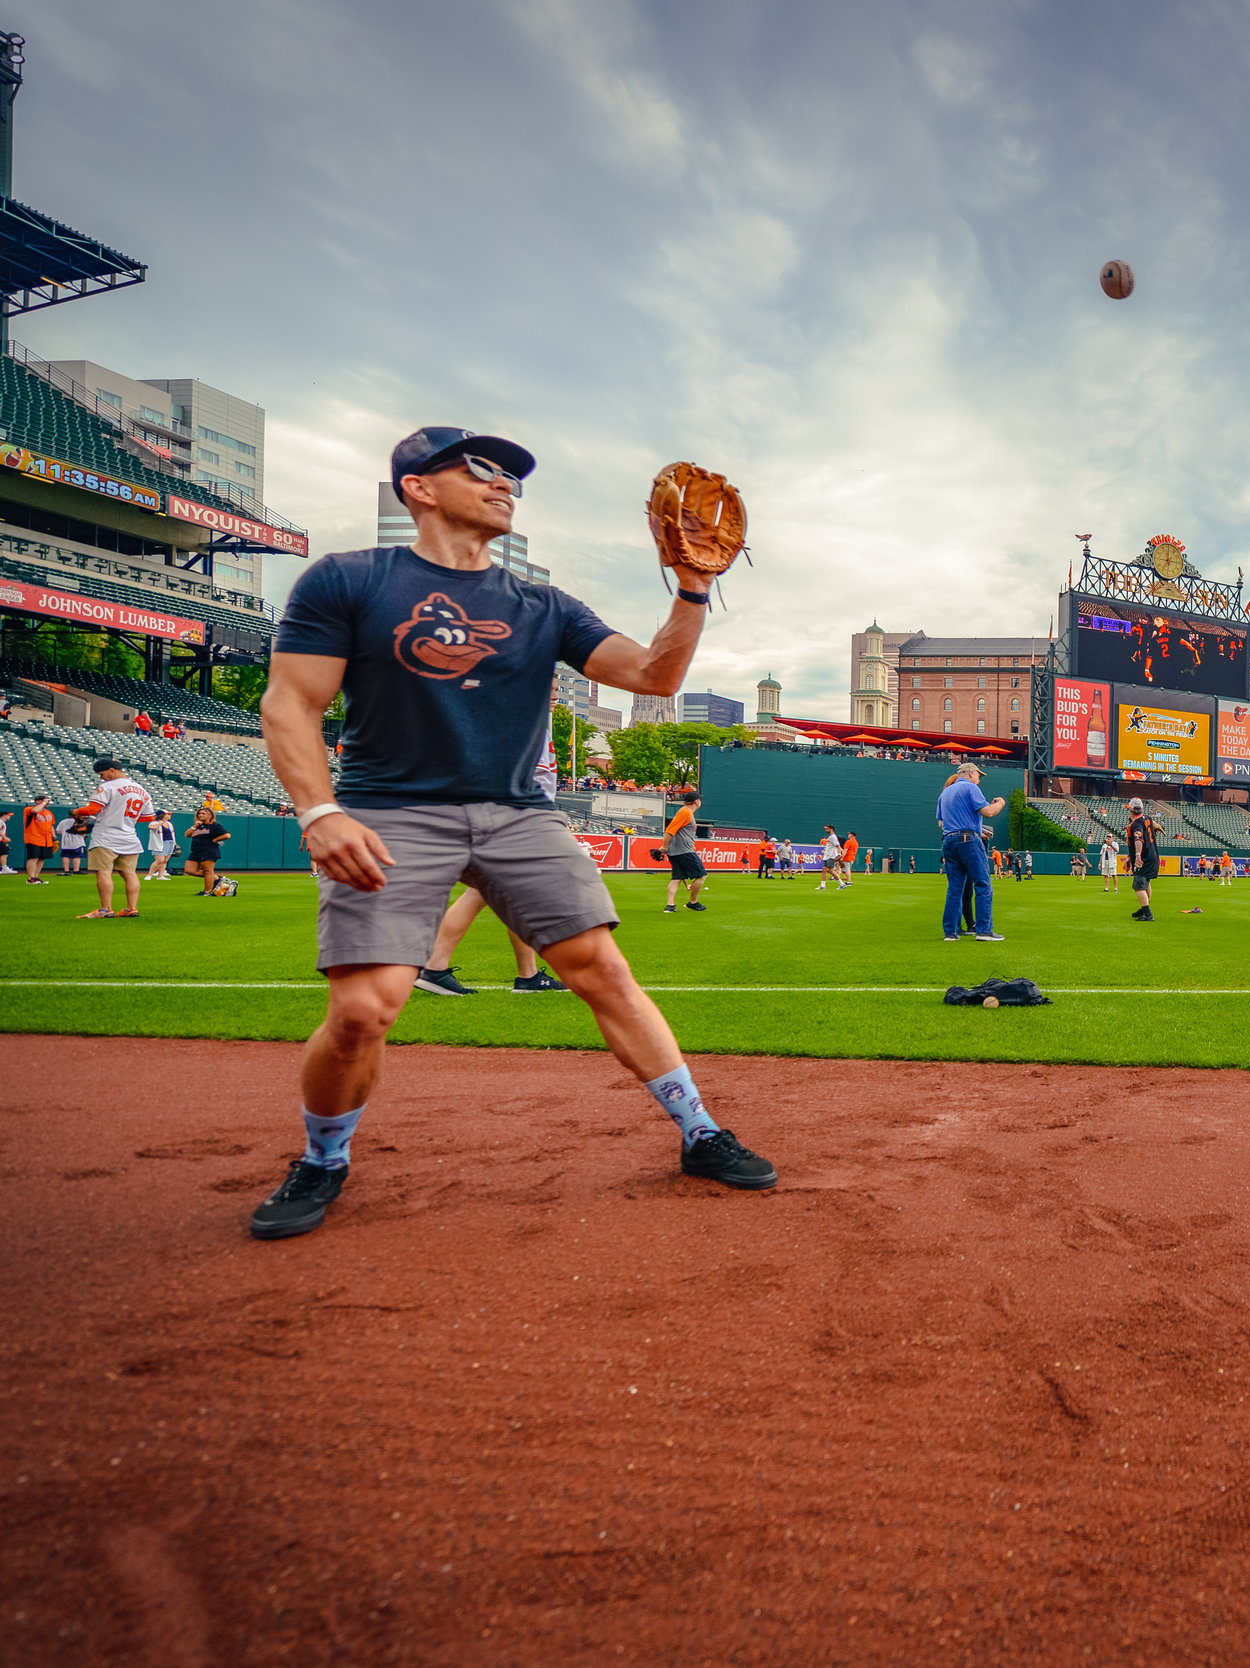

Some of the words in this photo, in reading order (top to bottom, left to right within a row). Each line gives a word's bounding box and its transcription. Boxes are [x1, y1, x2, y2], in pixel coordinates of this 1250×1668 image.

[34, 459, 133, 500] 11:35:56
[134, 492, 156, 507] AM
[174, 500, 262, 539] NYQUIST
[273, 531, 293, 545] 60
[273, 540, 305, 554] BALTIMORE
[1102, 569, 1140, 594] THE
[1194, 588, 1229, 611] SUN
[38, 593, 114, 622] JOHNSON
[119, 610, 176, 634] LUMBER
[1056, 686, 1081, 700] THIS
[1056, 700, 1088, 715] BUD'S
[1056, 714, 1077, 727] FOR
[1056, 727, 1080, 741] YOU.
[1222, 724, 1247, 736] MAKE
[1221, 734, 1248, 746] TODAY
[1221, 744, 1239, 755] THE
[1148, 752, 1153, 760] 5
[1153, 753, 1180, 763] MINUTES
[1123, 759, 1157, 770] REMAINING
[1157, 762, 1165, 771] IN
[1165, 763, 1177, 772] THE
[1177, 764, 1202, 774] SESSION
[124, 798, 144, 818] 19
[600, 805, 630, 813] CHEVROLET
